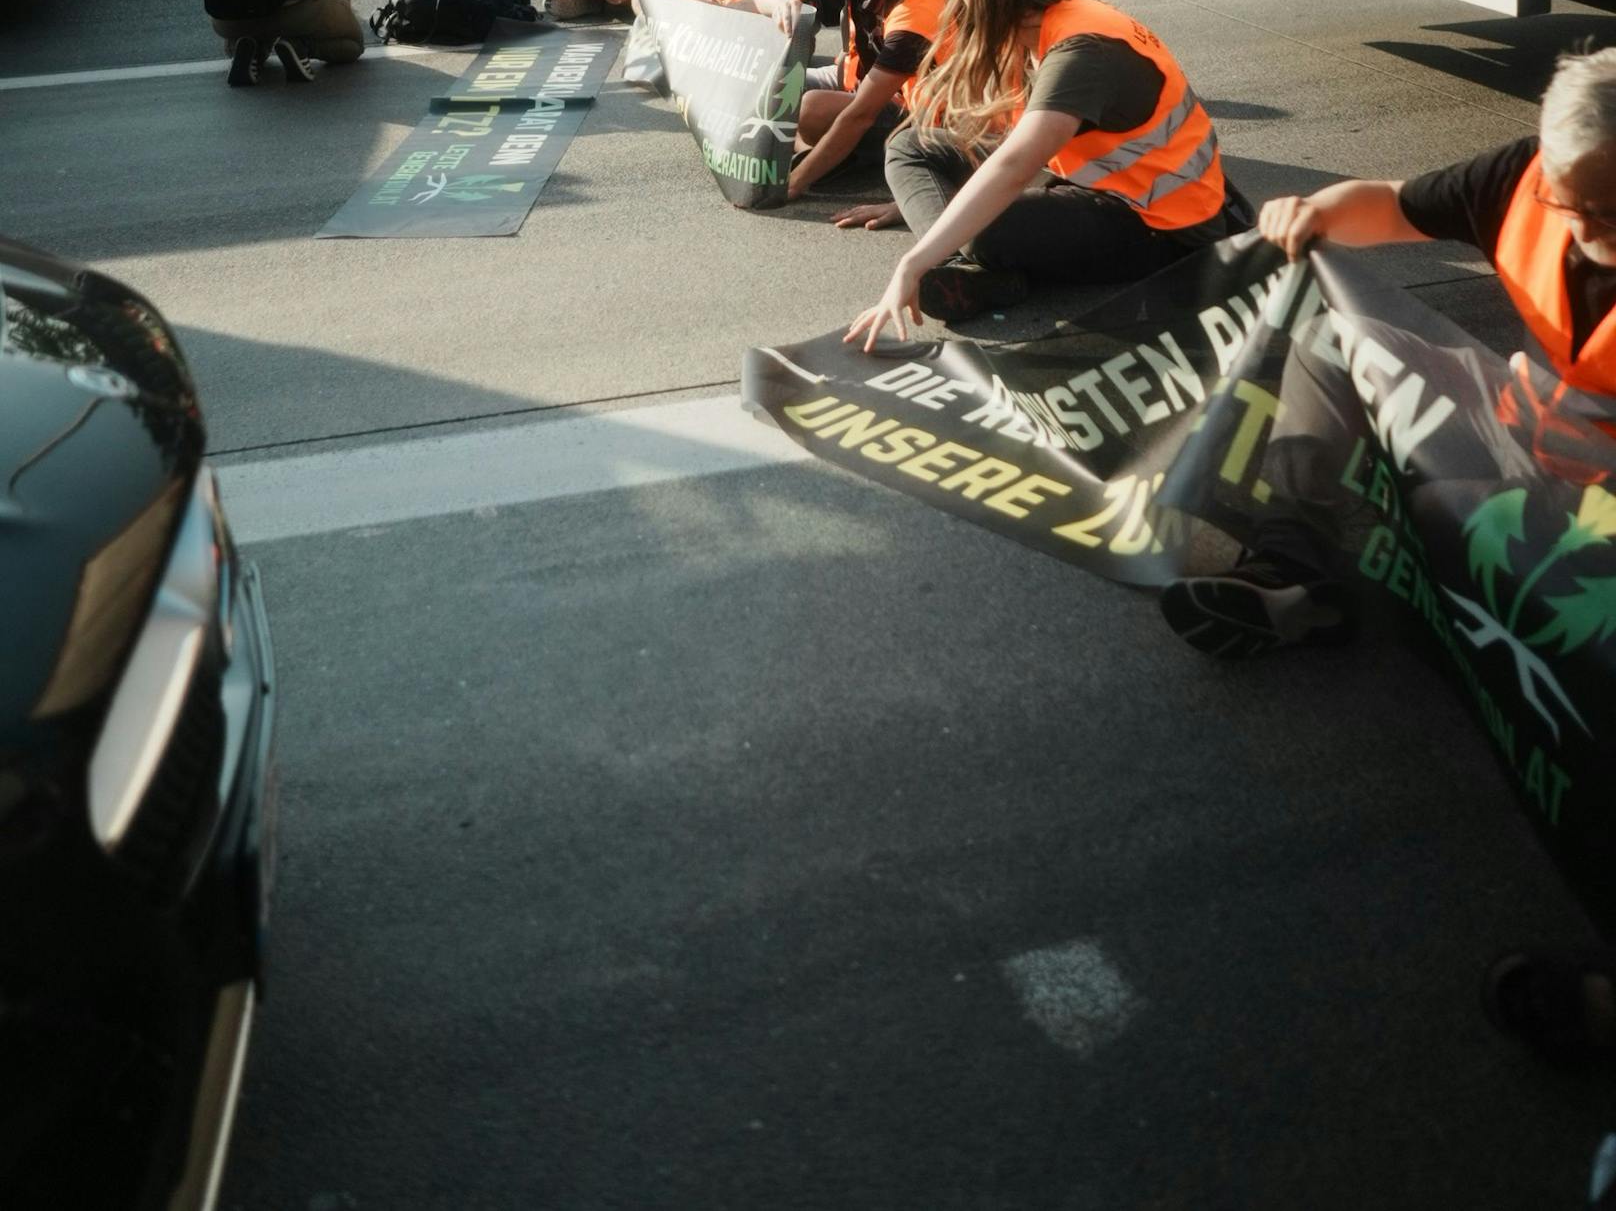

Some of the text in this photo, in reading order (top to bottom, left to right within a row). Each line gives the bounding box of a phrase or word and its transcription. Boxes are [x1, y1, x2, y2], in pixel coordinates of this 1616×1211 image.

[484, 46, 543, 70] NUR
[488, 134, 548, 166] DENN
[863, 362, 978, 410] DIE
[783, 396, 1073, 519] UNSERE
